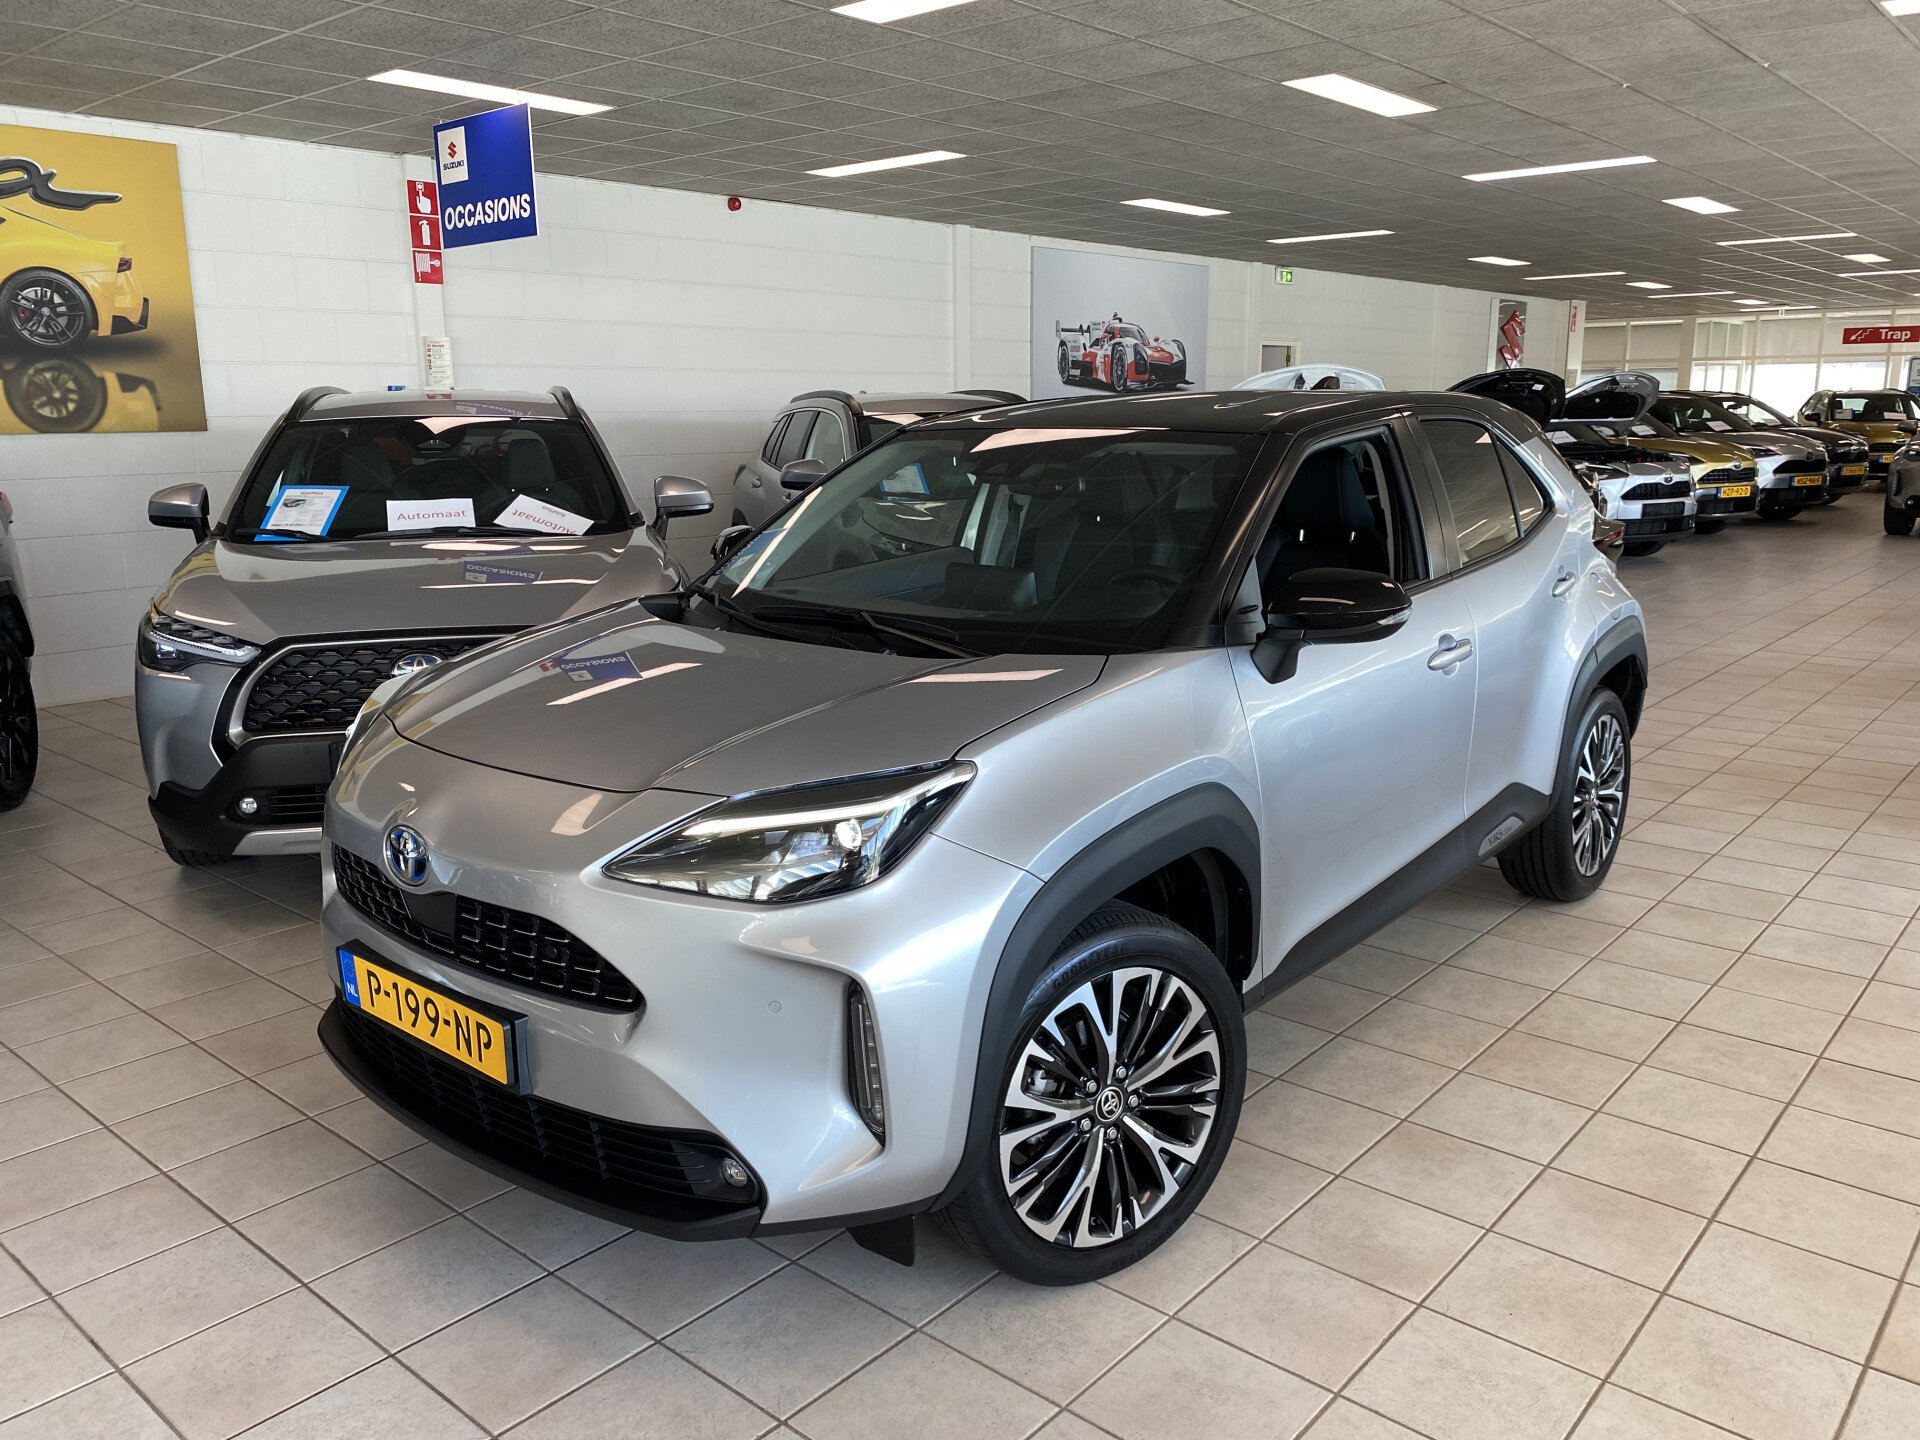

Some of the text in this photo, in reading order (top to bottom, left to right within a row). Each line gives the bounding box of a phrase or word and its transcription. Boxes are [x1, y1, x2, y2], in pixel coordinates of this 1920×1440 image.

[443, 160, 465, 171] SUZUKI
[444, 193, 531, 231] OCCASIONS
[1879, 328, 1911, 342] Trap
[397, 509, 467, 522] Automaat
[511, 508, 577, 535] Automaat
[346, 981, 359, 998] NL
[366, 969, 493, 1064] P-199-NP
